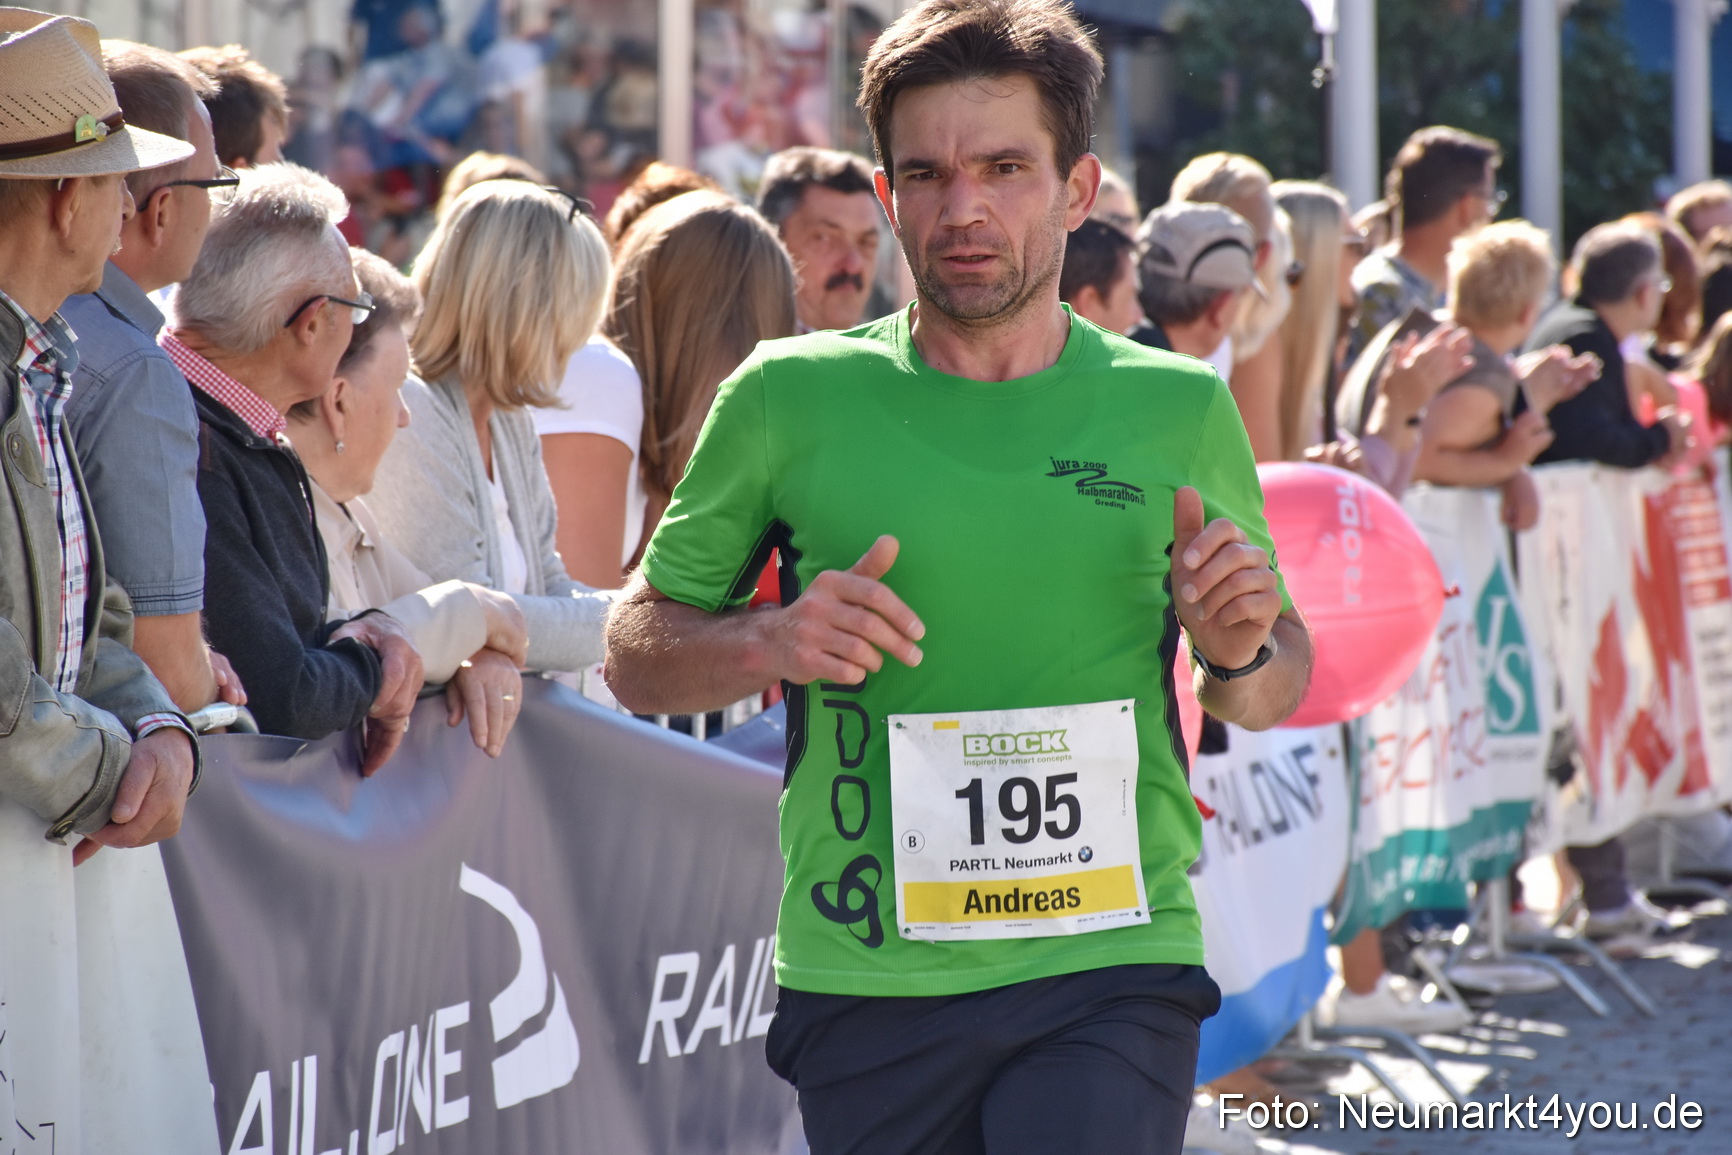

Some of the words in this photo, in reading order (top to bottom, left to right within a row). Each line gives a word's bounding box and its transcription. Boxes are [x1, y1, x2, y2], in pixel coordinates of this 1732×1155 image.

[1050, 456, 1080, 476] jura
[1083, 461, 1107, 470] 2000
[1077, 486, 1140, 504] Halbmarathon
[1095, 499, 1126, 510] Greding
[963, 729, 1070, 757] BOCK
[964, 758, 997, 768] inspired
[1000, 757, 1009, 766] by
[1011, 756, 1034, 765] smart
[1037, 754, 1073, 763] concepts
[955, 772, 1081, 846] 195
[908, 836, 917, 848] B
[949, 858, 1001, 872] PARTL
[1004, 852, 1073, 870] Neumarkt
[963, 886, 1081, 915] Andreas
[638, 934, 776, 1064] RAIL
[210, 1001, 470, 1155] AIL.ONE
